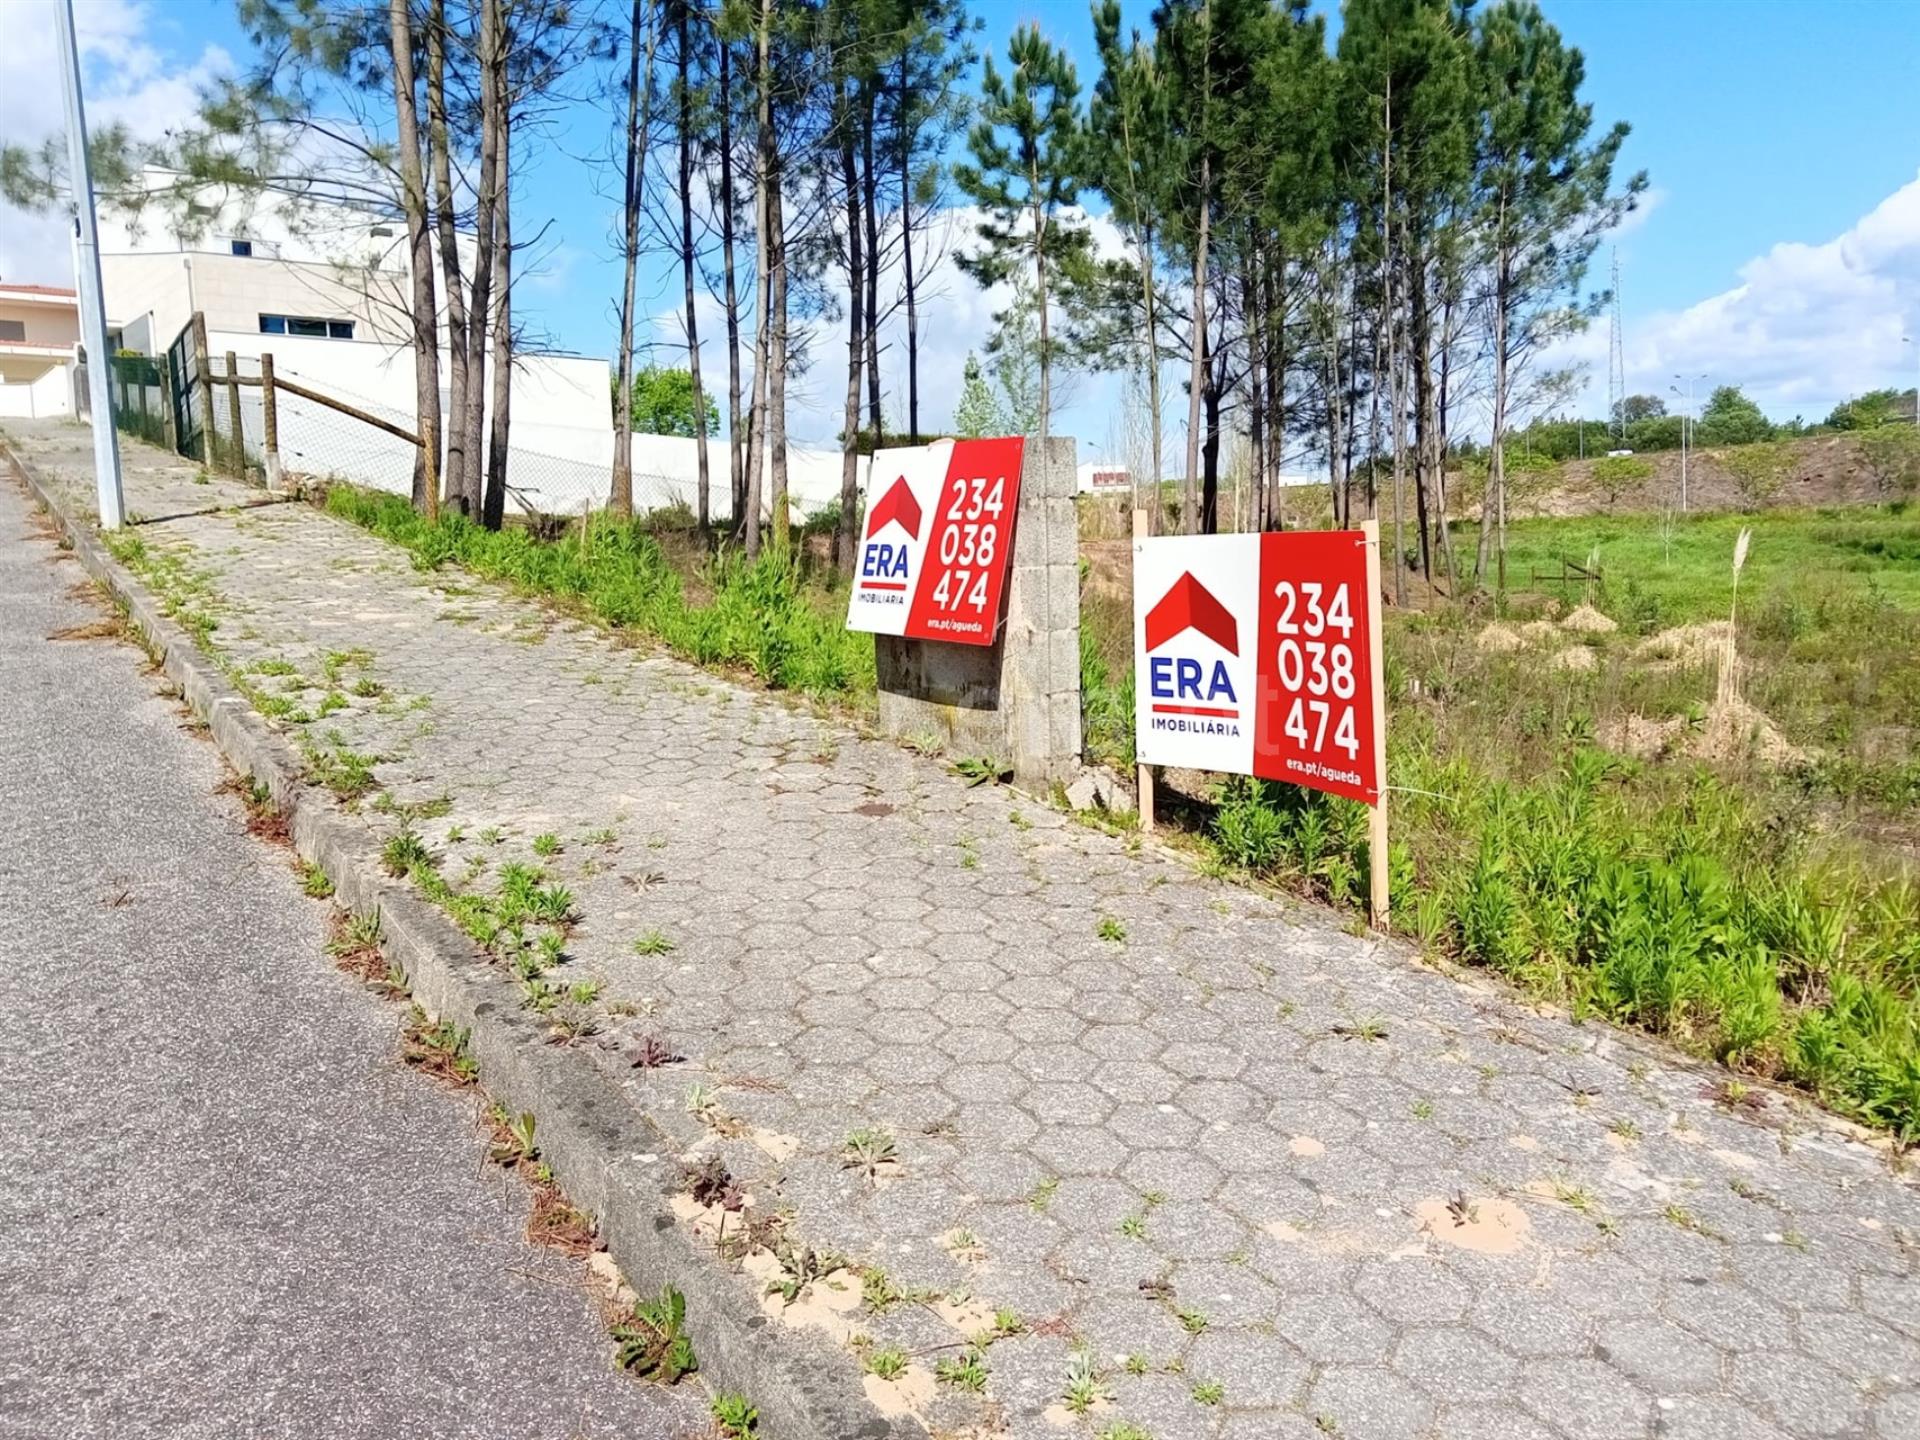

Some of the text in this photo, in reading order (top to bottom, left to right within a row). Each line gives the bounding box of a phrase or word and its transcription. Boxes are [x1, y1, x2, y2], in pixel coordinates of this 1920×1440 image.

[946, 477, 1005, 521] 234
[862, 543, 908, 578] ERA
[939, 523, 997, 567] 038
[932, 569, 989, 613] 474
[1274, 580, 1354, 639] 234
[927, 618, 983, 633] era.pt/agueda
[1150, 656, 1238, 703] ERA
[1277, 638, 1356, 700] 038
[1151, 717, 1241, 737] IMOBILIÁRIA
[1284, 697, 1360, 761] 474
[1286, 758, 1362, 785] era.pt/agueda
